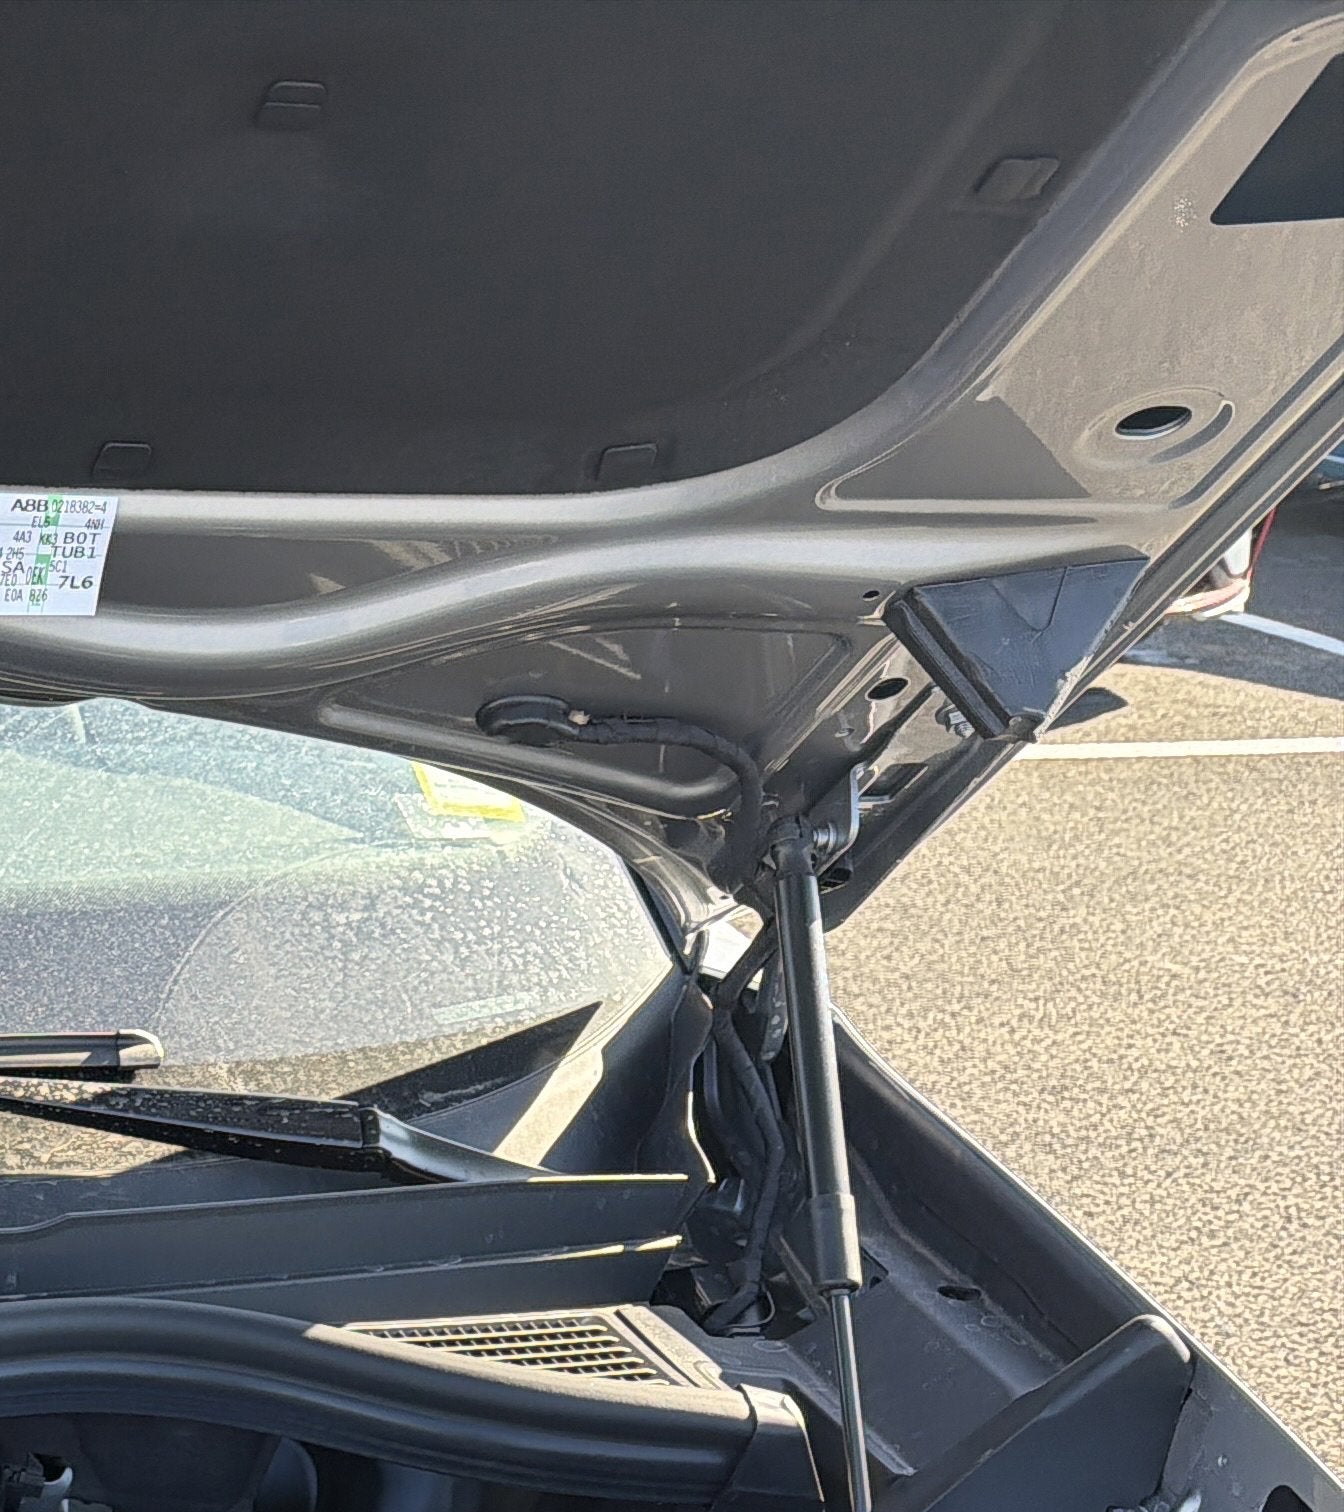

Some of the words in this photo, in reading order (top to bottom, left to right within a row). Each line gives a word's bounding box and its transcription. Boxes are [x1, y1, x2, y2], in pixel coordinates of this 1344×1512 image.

[11, 498, 49, 512] A8B
[12, 530, 32, 544] 4A3
[51, 545, 97, 559] TUB1
[49, 559, 68, 573] 5C1
[58, 575, 95, 590] 7L6
